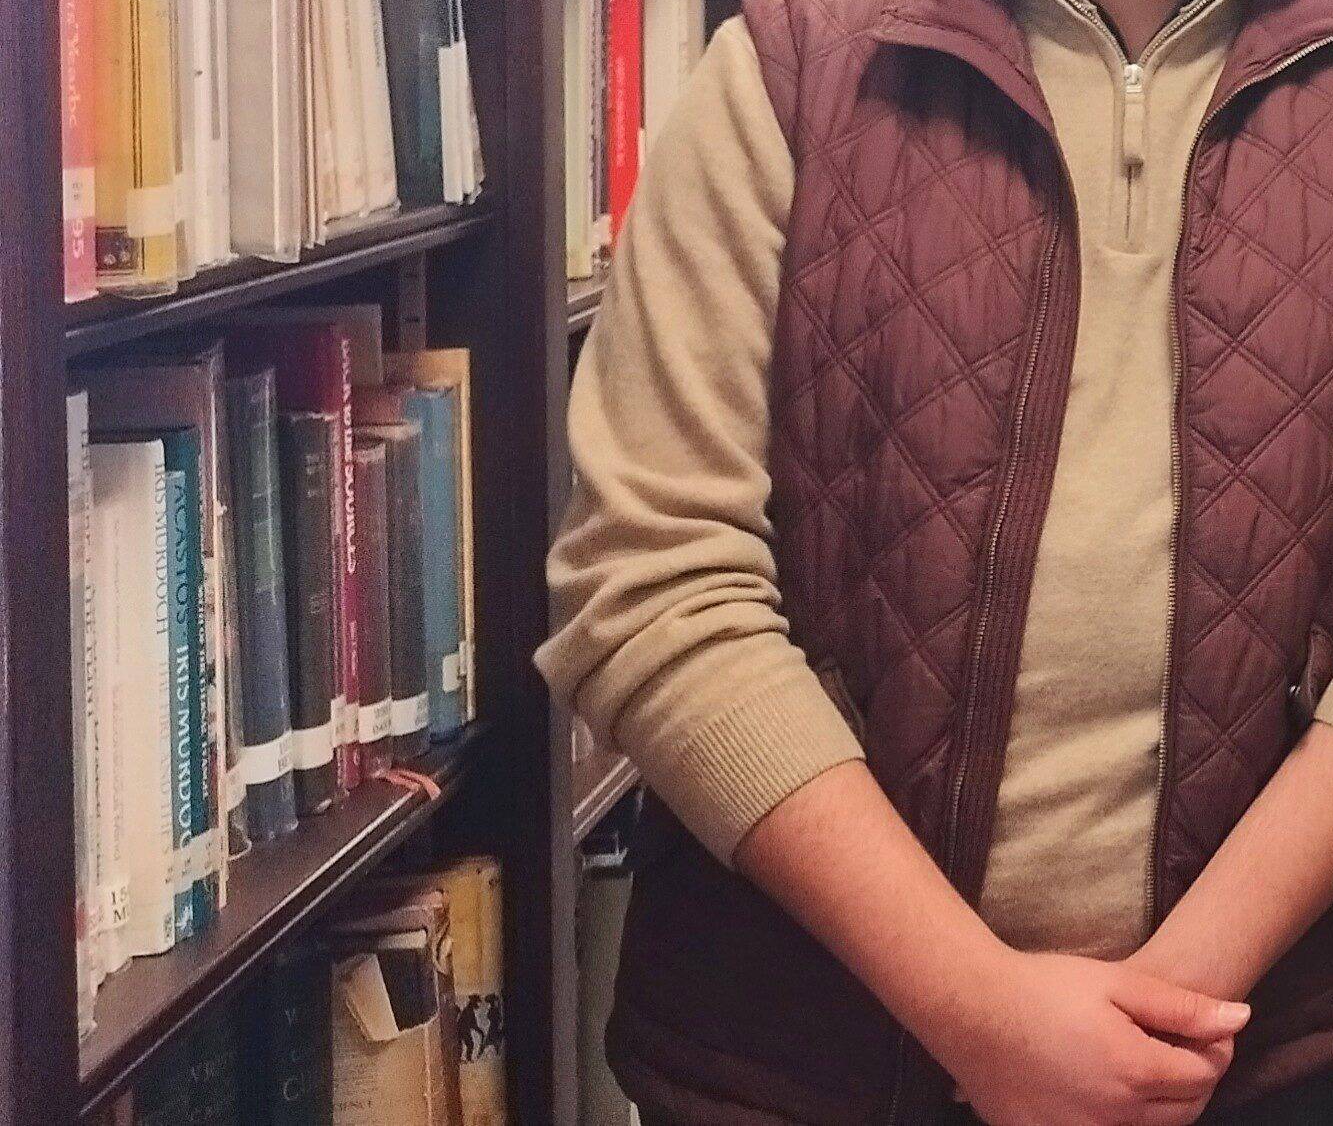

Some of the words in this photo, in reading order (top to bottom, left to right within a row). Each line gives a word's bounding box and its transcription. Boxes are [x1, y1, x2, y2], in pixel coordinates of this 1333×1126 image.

[154, 462, 168, 504] IRIS
[155, 509, 170, 635] MURDOCH
[173, 485, 191, 625] ACASTOS
[175, 644, 192, 699] IRIS
[175, 705, 195, 851] MURDOC
